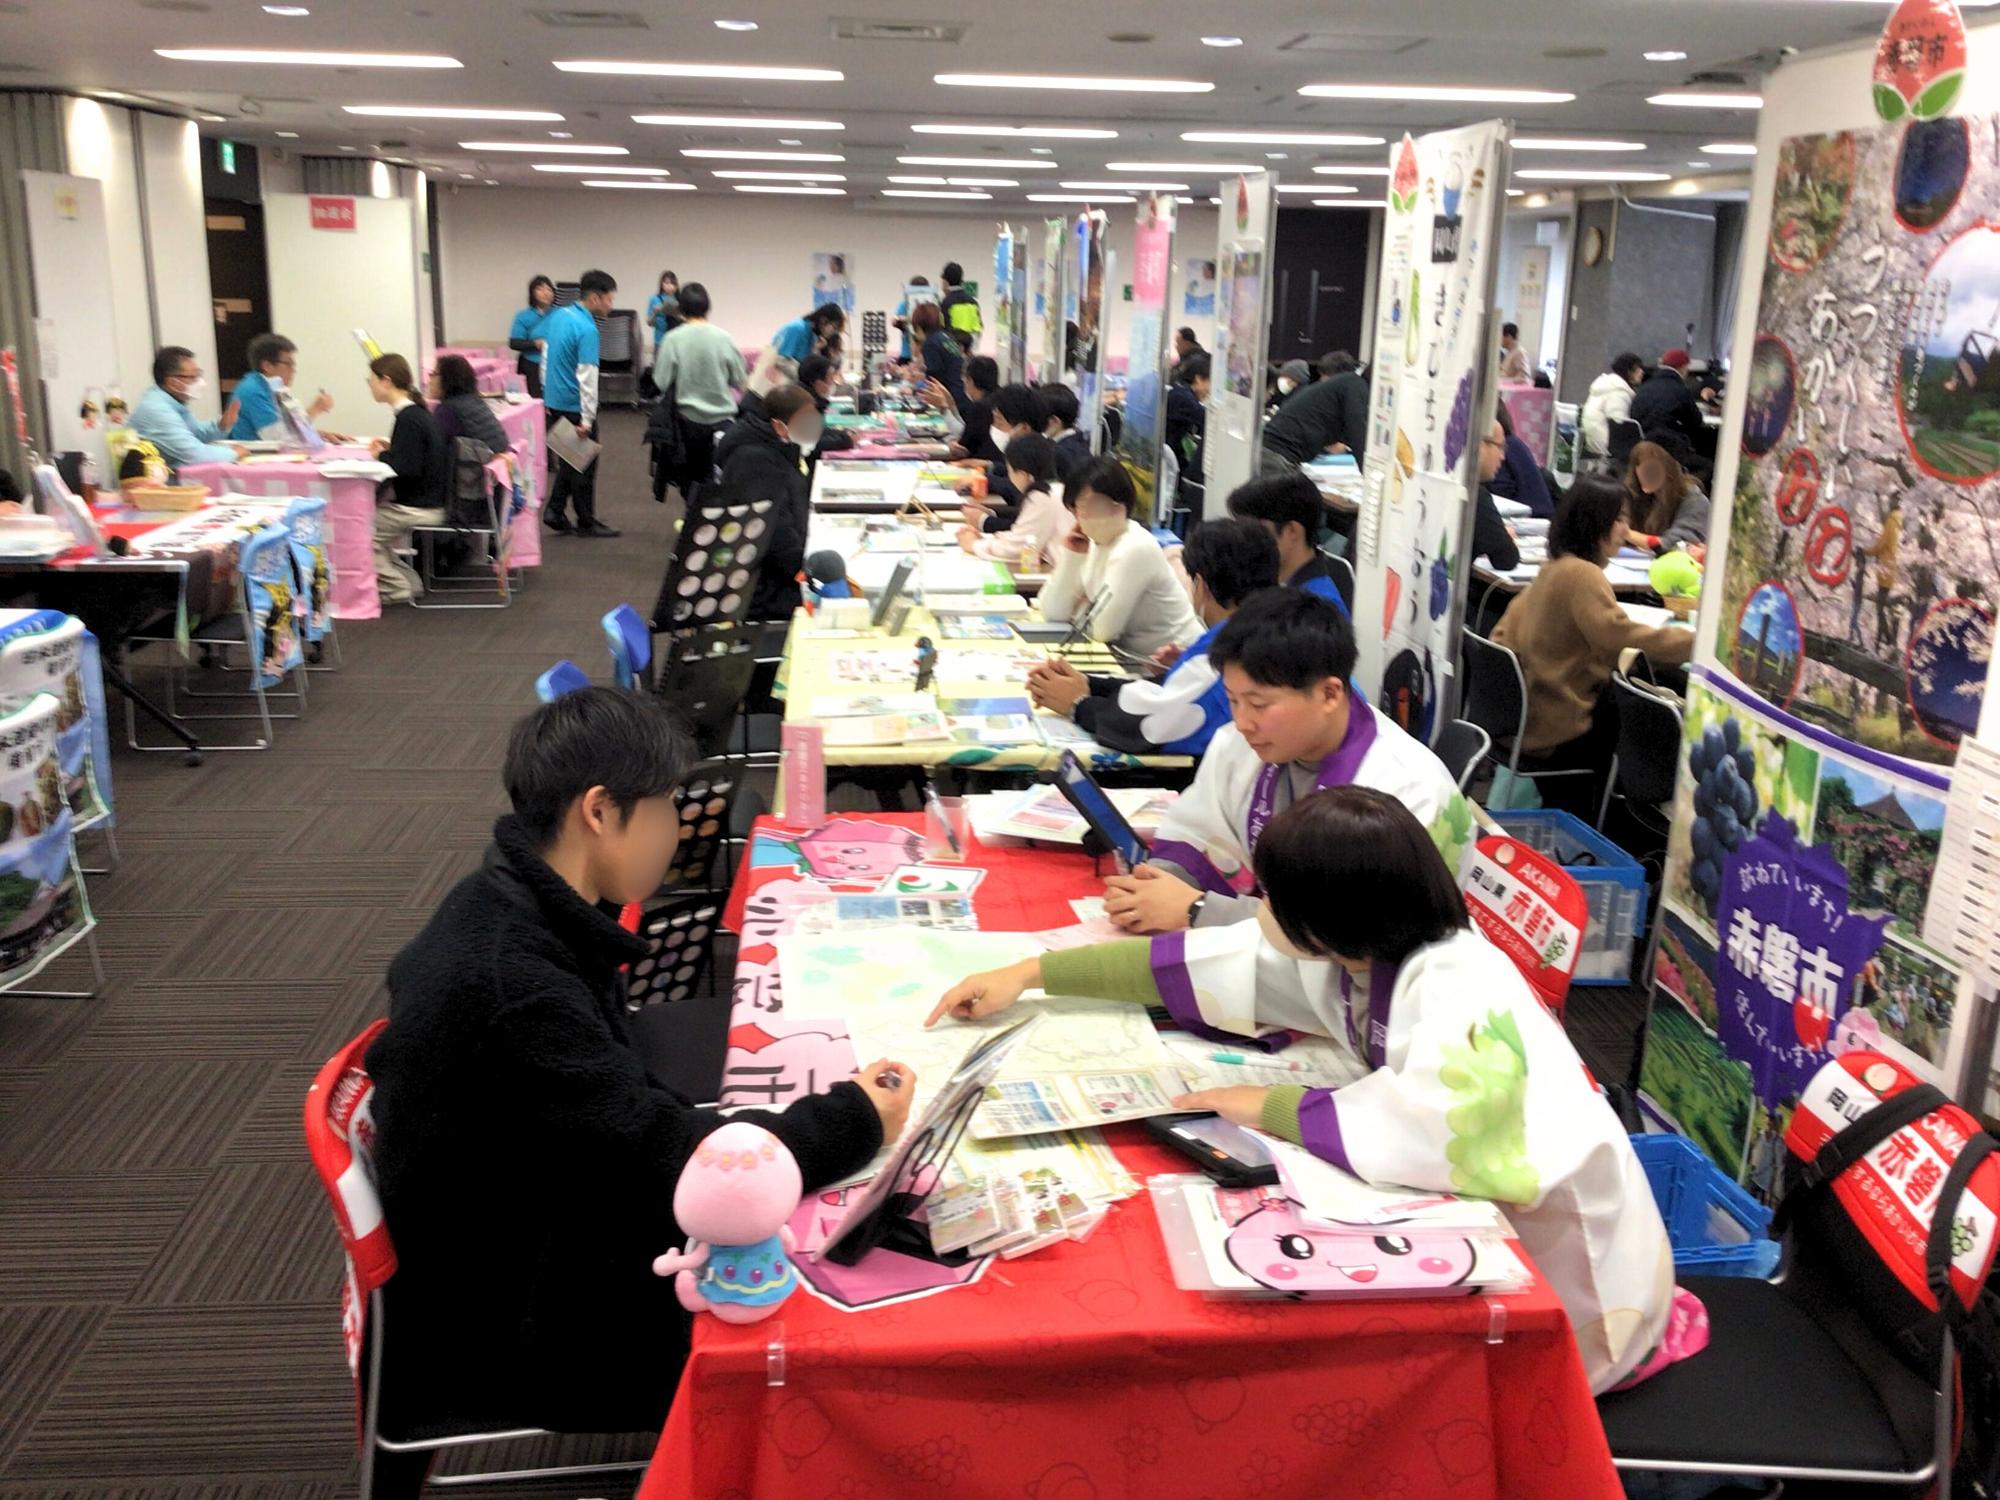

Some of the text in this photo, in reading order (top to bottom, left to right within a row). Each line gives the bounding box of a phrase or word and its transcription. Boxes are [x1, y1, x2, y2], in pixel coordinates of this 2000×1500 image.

[1727, 907, 1843, 1019] 赤磐市
[1826, 1087, 1864, 1122] 岡山
[1880, 1133, 1942, 1208] 赤磐
